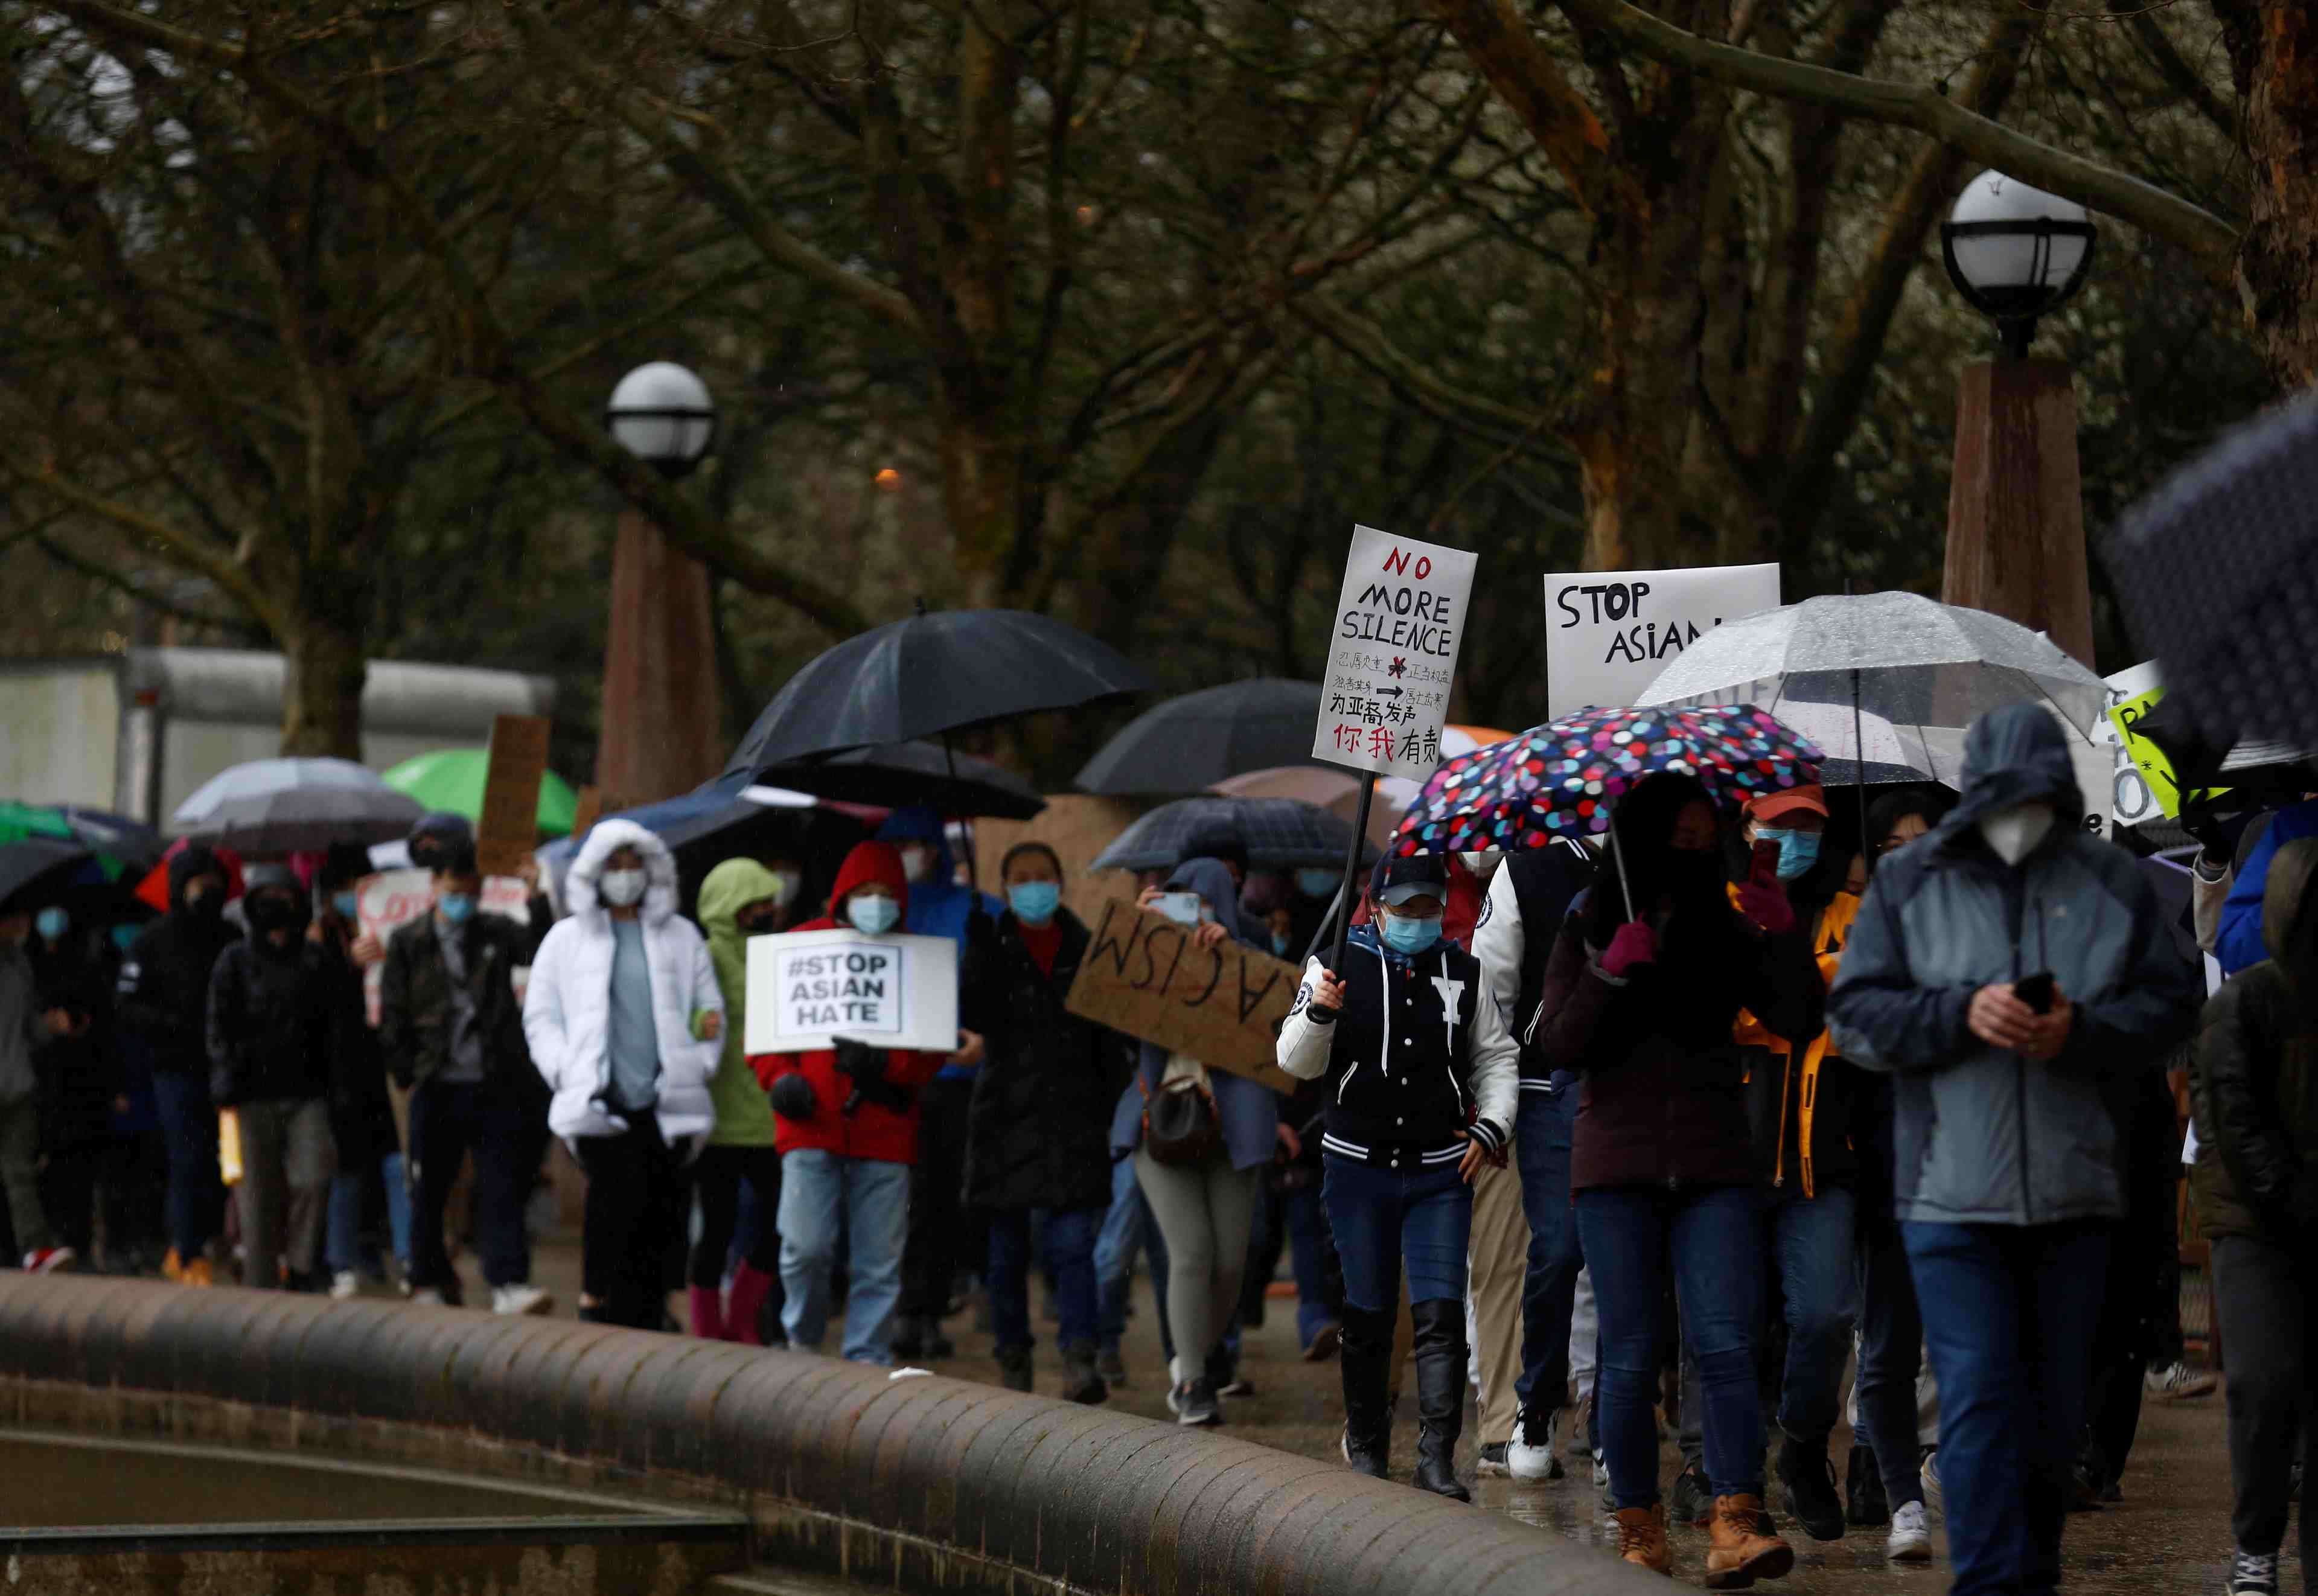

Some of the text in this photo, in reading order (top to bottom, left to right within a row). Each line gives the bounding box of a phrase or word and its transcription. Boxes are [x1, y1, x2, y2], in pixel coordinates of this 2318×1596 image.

[1382, 546, 1431, 580] NO
[1358, 583, 1451, 625] MORE
[1557, 582, 1650, 628] STOP
[1341, 611, 1452, 657] SILENCE
[1332, 675, 1373, 695] 独善其身
[1405, 663, 1450, 686] 正当权益
[1330, 692, 1416, 726] 为亚裔发声
[1333, 723, 1438, 765] 你我有责
[790, 953, 887, 976] #STOP
[1086, 902, 1297, 1026] ACISM
[791, 977, 885, 1001] ASIAN
[1430, 975, 1465, 1026] Y
[797, 1002, 879, 1026] HATE
